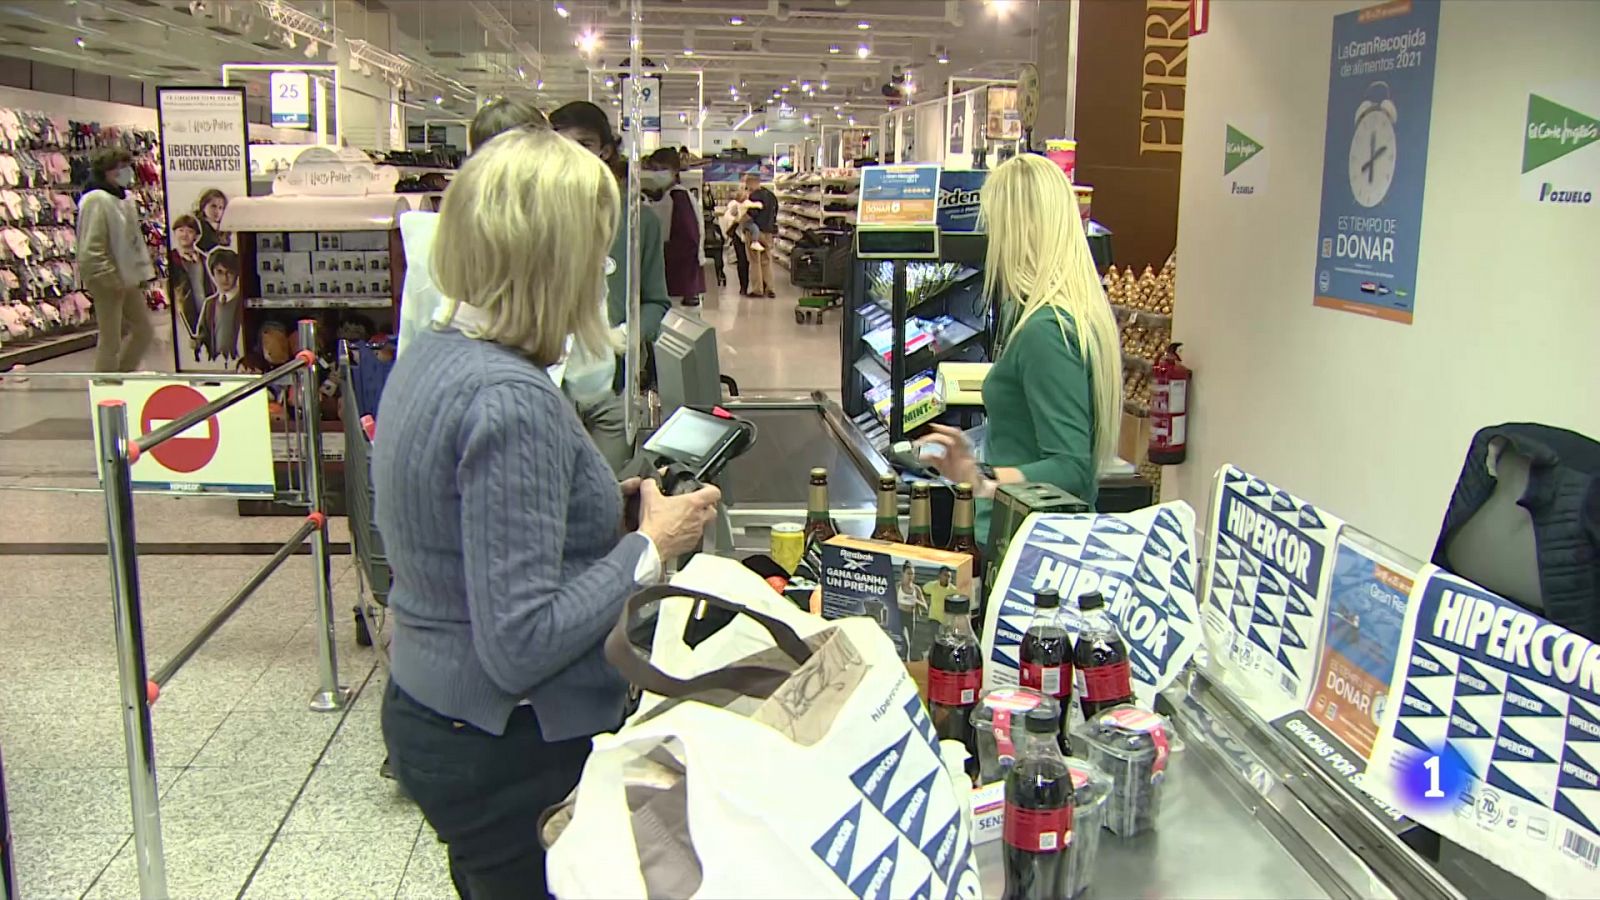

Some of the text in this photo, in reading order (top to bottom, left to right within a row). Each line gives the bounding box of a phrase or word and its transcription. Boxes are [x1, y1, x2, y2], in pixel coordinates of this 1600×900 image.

[1340, 51, 1421, 77] de alimentos 2021
[279, 84, 299, 98] 25
[1140, 0, 1190, 156] FERR
[169, 159, 241, 171] A HOGWARTS!!
[1539, 182, 1592, 203] POZUELO
[1338, 216, 1397, 234] ES TIEMPO DE
[1336, 233, 1394, 263] DONAR
[1227, 496, 1312, 585] HIPERCOR
[840, 549, 874, 562] Reebok
[826, 567, 888, 586] GANA GANHA
[826, 576, 842, 587] UN
[1032, 555, 1169, 660] HIPERCOR
[1433, 589, 1600, 695] HIPERCOR
[1326, 671, 1371, 715] DONAR
[1284, 719, 1335, 757] GRACIAS
[1325, 753, 1357, 777] POR
